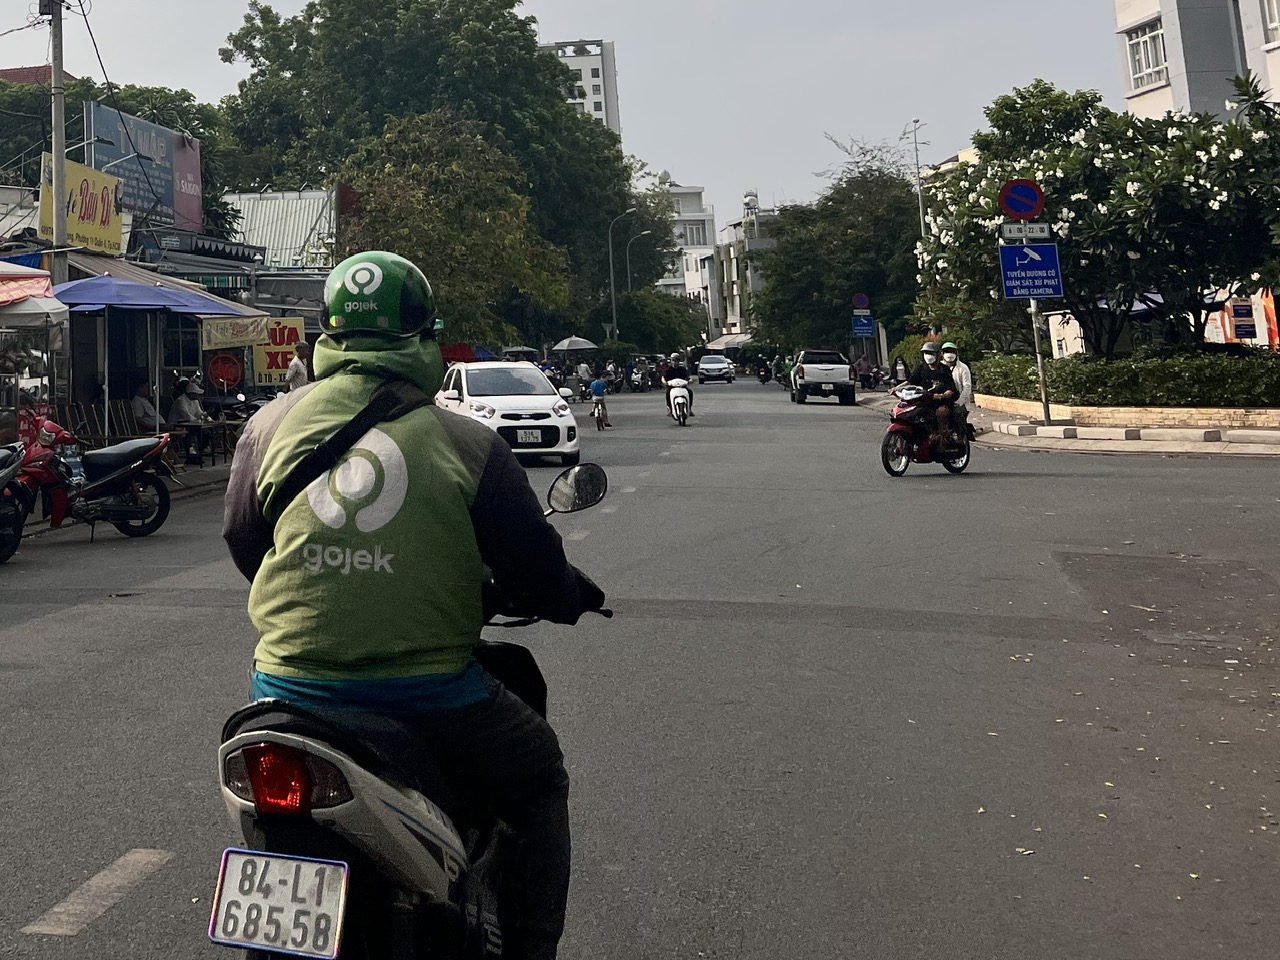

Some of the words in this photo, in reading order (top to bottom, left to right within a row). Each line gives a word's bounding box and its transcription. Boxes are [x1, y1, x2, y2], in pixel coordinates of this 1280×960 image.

[1006, 278, 1020, 287] GIÁM
[1035, 277, 1042, 286] XỬ
[1044, 278, 1058, 286] PHẠT
[1007, 269, 1025, 278] TUYẾN
[1048, 268, 1055, 277] CÓ
[1013, 287, 1029, 295] BẰNG
[1030, 287, 1053, 295] CAMERA
[344, 300, 378, 312] gojek
[258, 321, 300, 346] ỬA
[303, 543, 395, 575] gojek
[238, 858, 327, 907] 84-L1
[222, 899, 332, 952] 685.58
